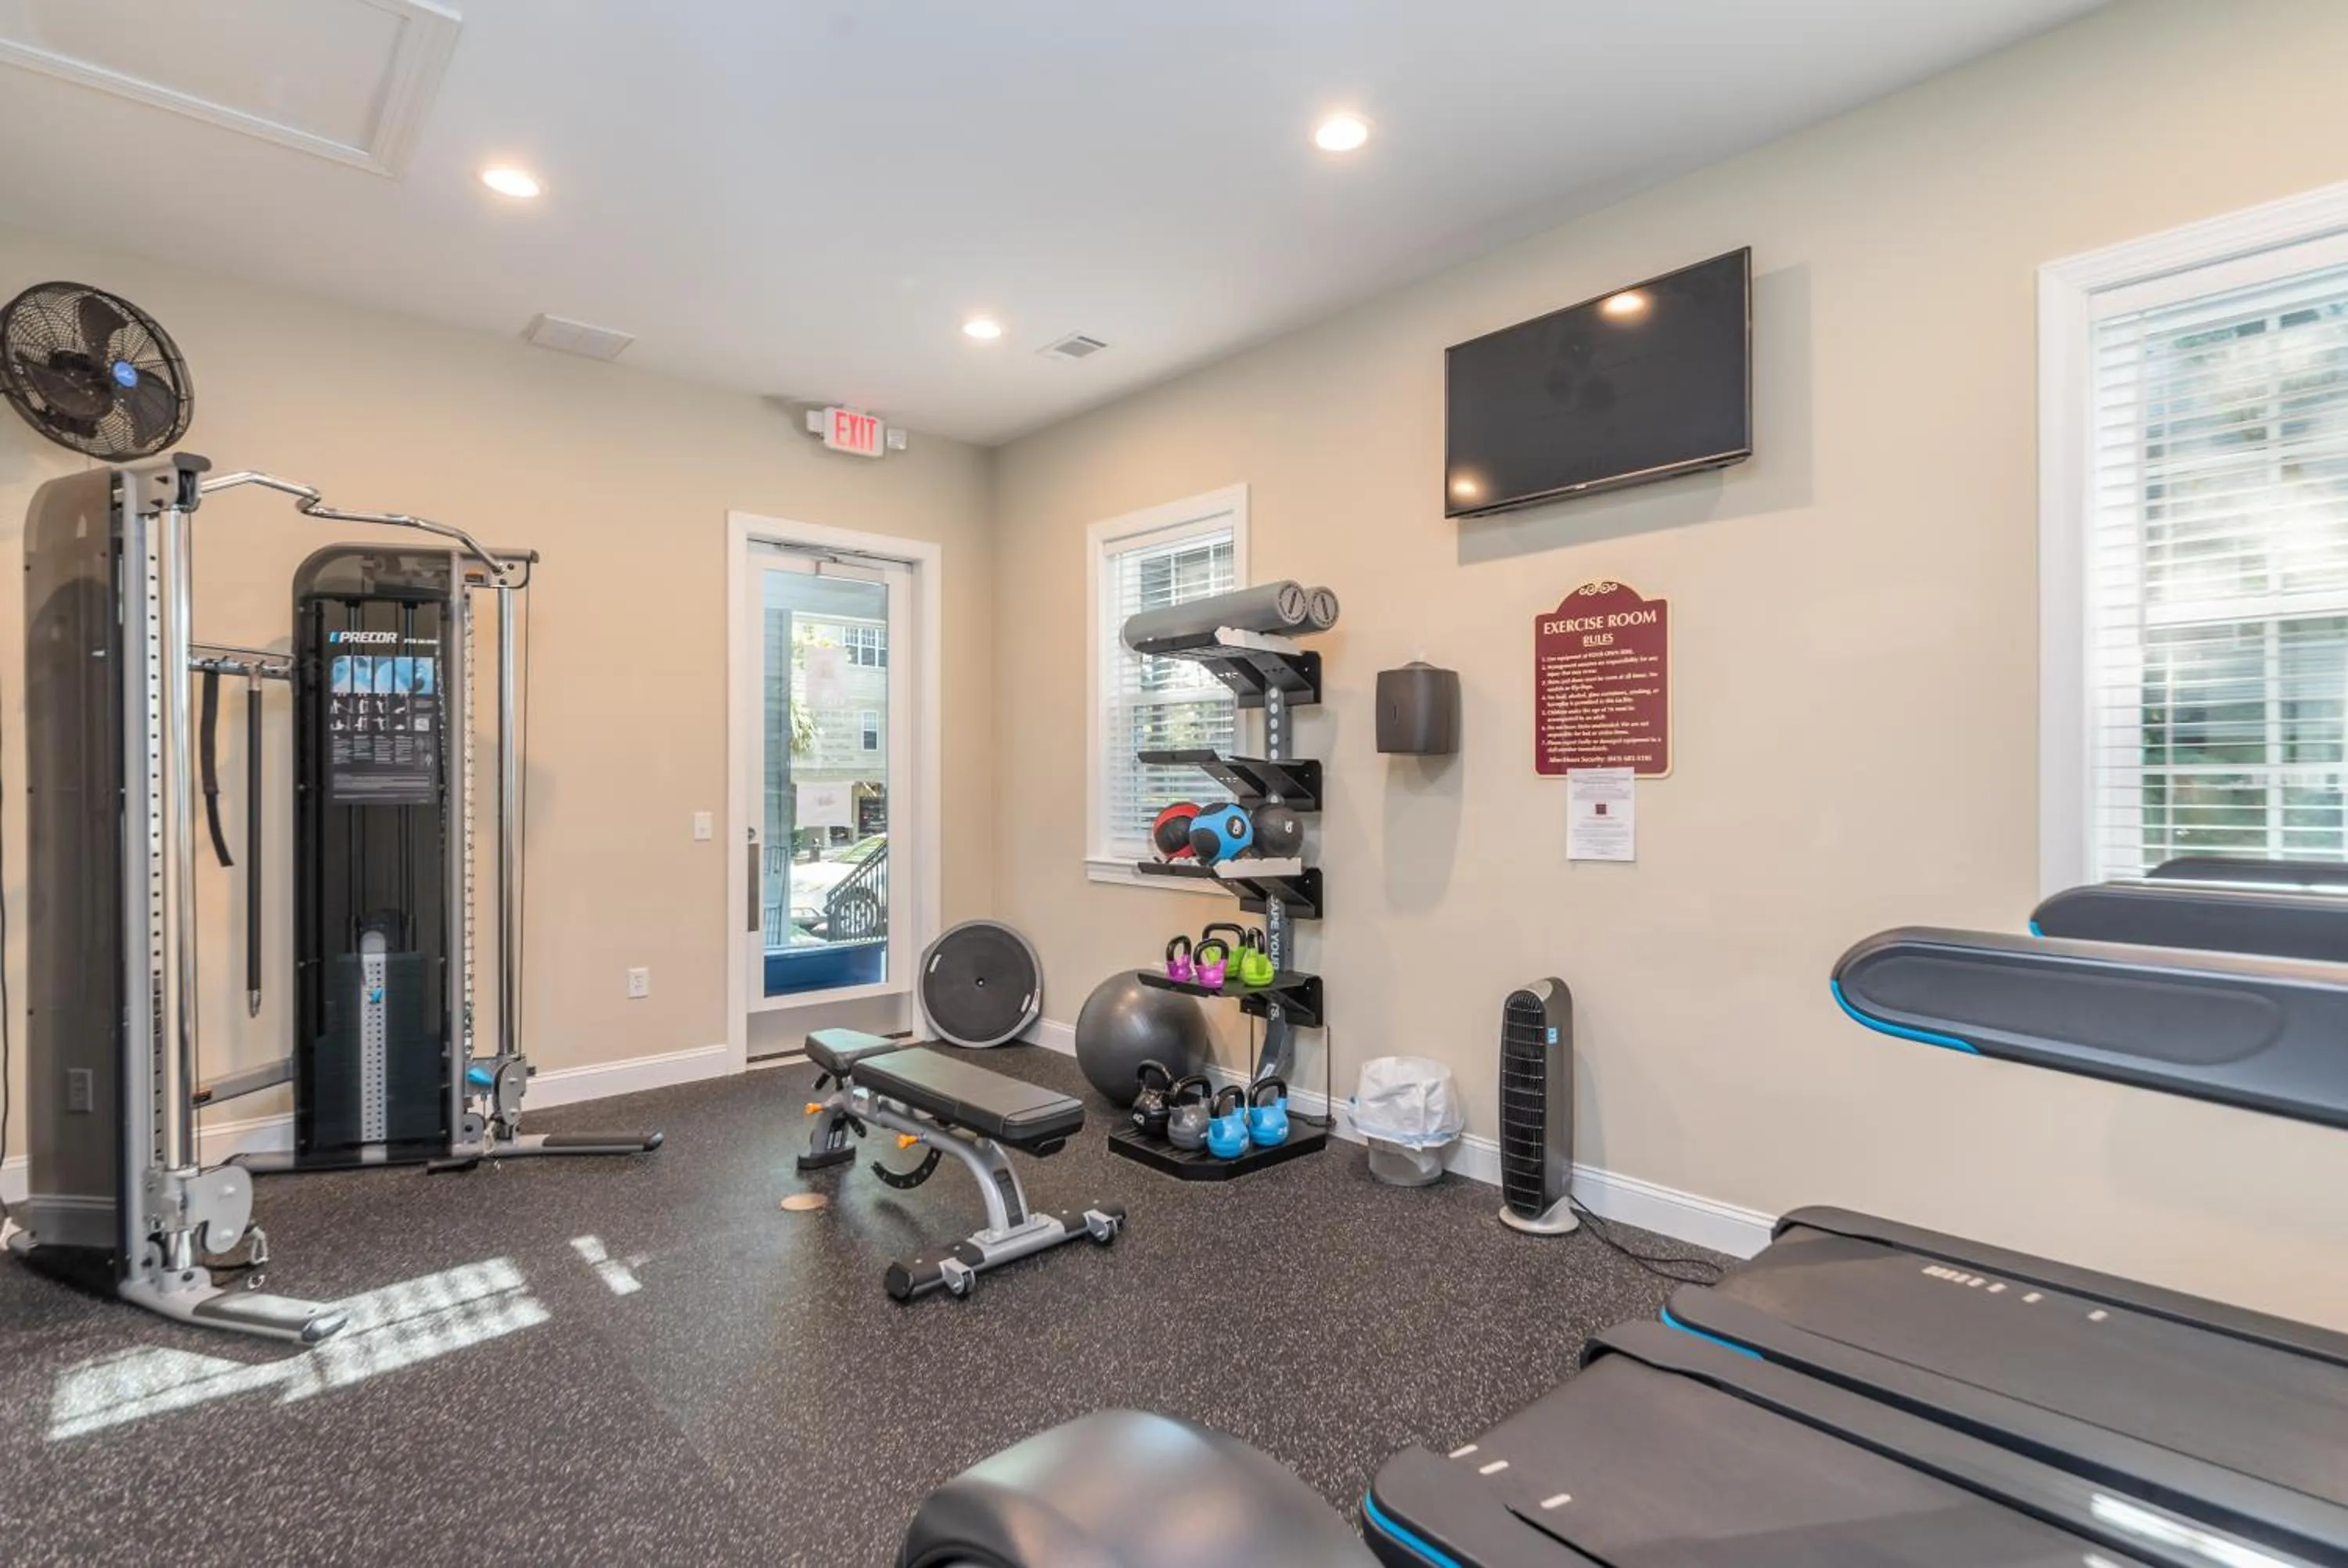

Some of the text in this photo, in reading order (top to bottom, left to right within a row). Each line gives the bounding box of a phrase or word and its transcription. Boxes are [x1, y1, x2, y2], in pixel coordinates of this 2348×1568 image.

[835, 412, 877, 451] EXIT
[1543, 610, 1657, 635] EXERCISE ROOM
[339, 631, 398, 644] PRECOR
[1583, 633, 1614, 646] RULES
